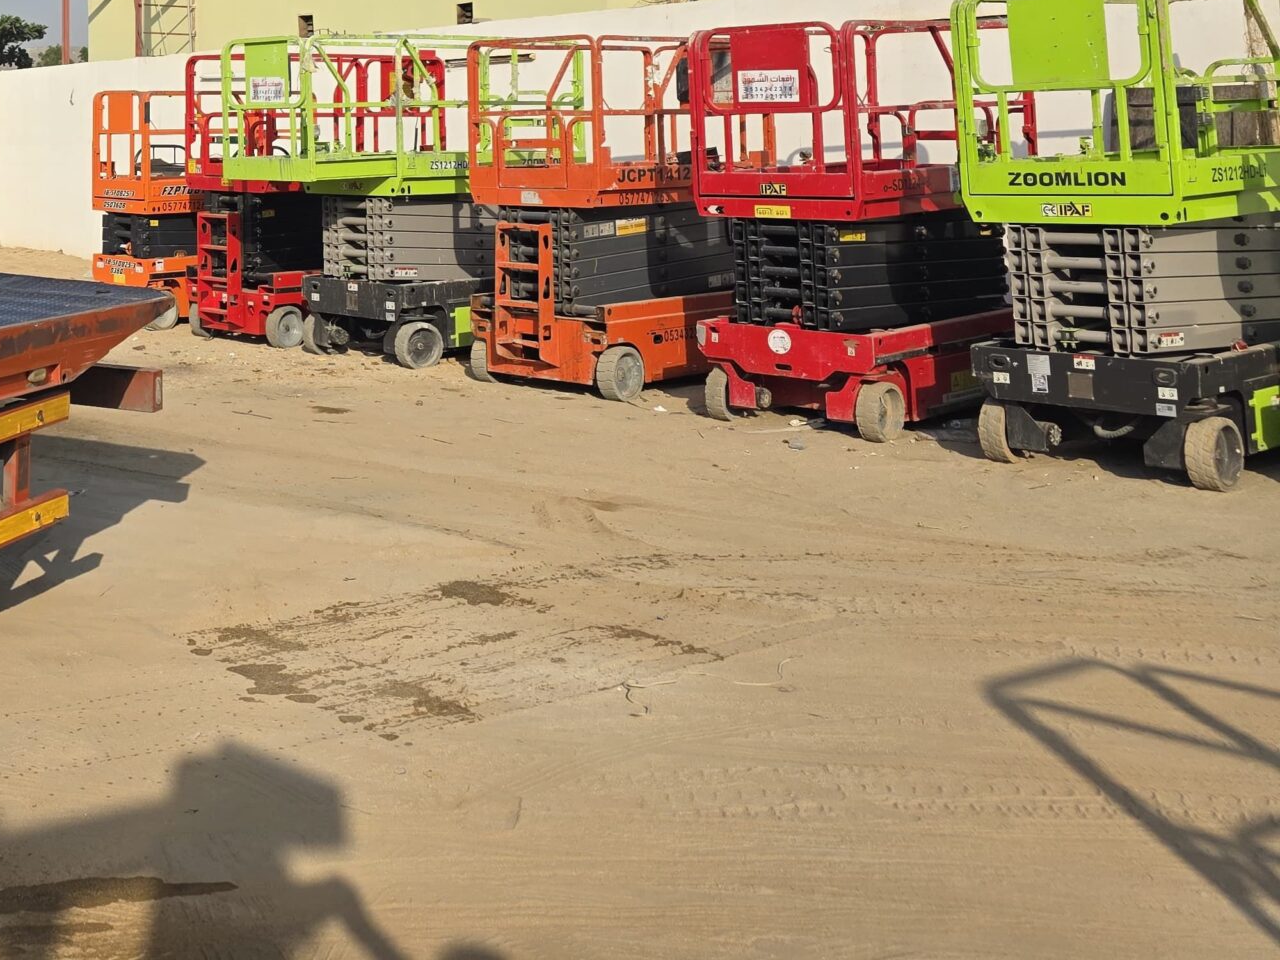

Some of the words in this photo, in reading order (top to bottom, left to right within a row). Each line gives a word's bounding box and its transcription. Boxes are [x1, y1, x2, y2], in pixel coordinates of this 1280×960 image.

[1008, 172, 1126, 187] ZOOMLION
[1211, 162, 1267, 183] ZS1212HD-Li
[761, 181, 786, 194] IPAF
[1059, 201, 1090, 216] IPAF
